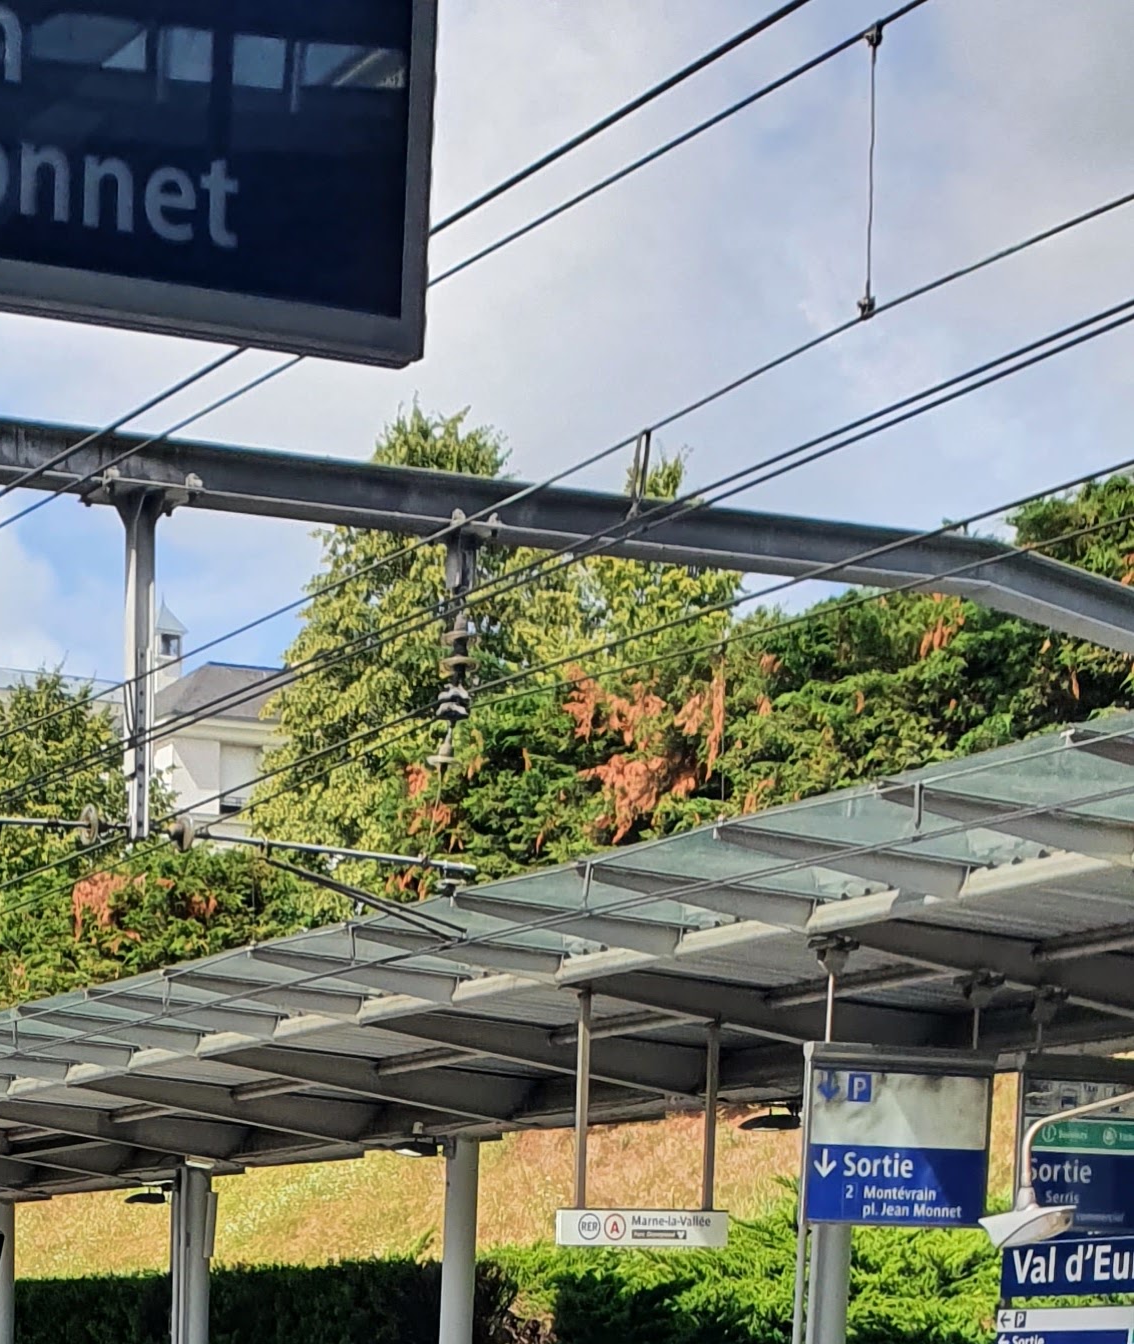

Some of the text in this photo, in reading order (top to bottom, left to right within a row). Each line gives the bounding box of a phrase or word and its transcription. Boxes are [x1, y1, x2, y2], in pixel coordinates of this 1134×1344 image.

[842, 1151, 914, 1179] Sortie
[845, 1184, 937, 1201] 2 Montévrain
[862, 1202, 962, 1218] pl. Jean Monnet
[580, 1221, 598, 1232] RER
[631, 1214, 712, 1228] Marne-la-Vallée
[1012, 1244, 1134, 1284] Val d'Eu
